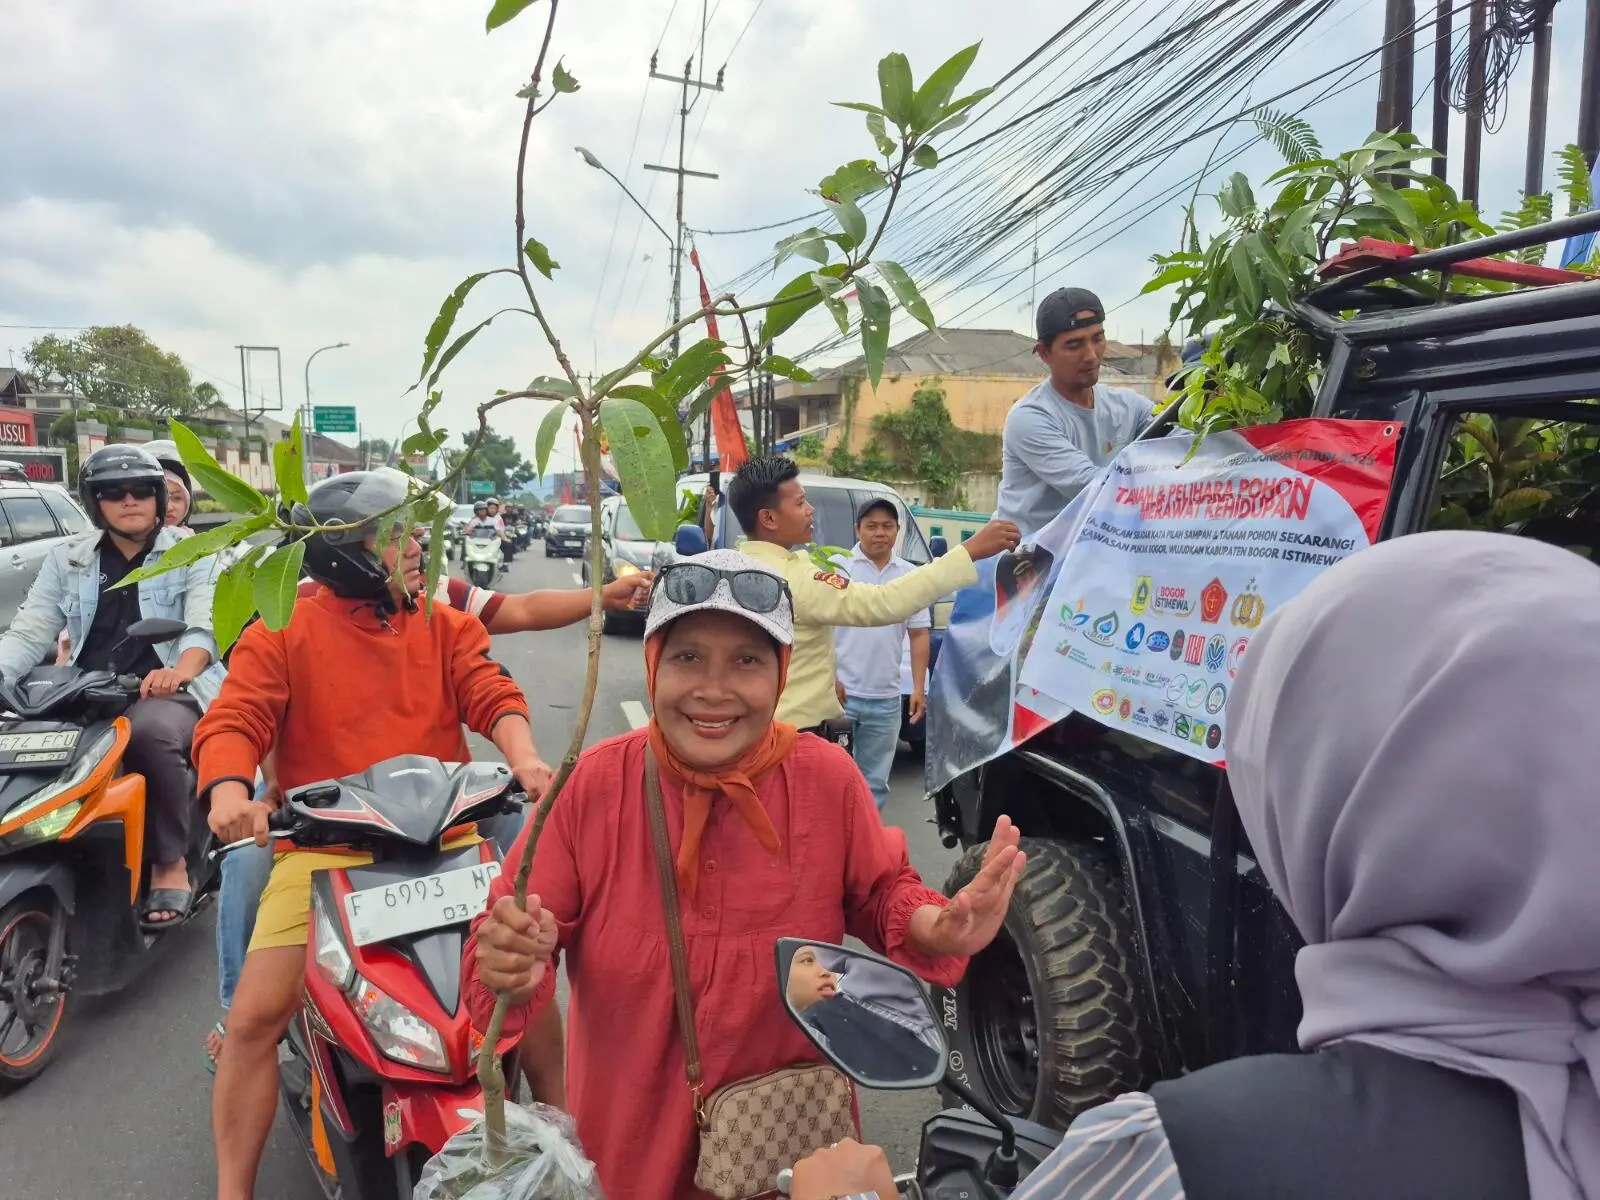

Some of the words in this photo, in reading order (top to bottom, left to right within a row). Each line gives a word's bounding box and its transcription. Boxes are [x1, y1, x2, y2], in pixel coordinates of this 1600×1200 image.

[1296, 450, 1336, 462] TAHUN
[1115, 486, 1155, 505] TANAM
[1167, 479, 1235, 505] PELIHARA
[1238, 476, 1316, 505] POHON
[1204, 496, 1309, 521] KEHIDUPAN
[1081, 528, 1130, 552] KAWASAN
[1205, 546, 1248, 557] KABUPATEN
[1249, 547, 1279, 560] BOGOR
[1100, 521, 1133, 539] BUKAN
[1184, 530, 1213, 540] SAMPAH
[1220, 530, 1246, 541] TANAM
[1248, 530, 1278, 542] POHON
[1279, 531, 1356, 551] SEKARANG!
[1154, 597, 1189, 611] ISTIMEWA
[1160, 586, 1185, 599] BOGOR
[351, 894, 362, 917] F
